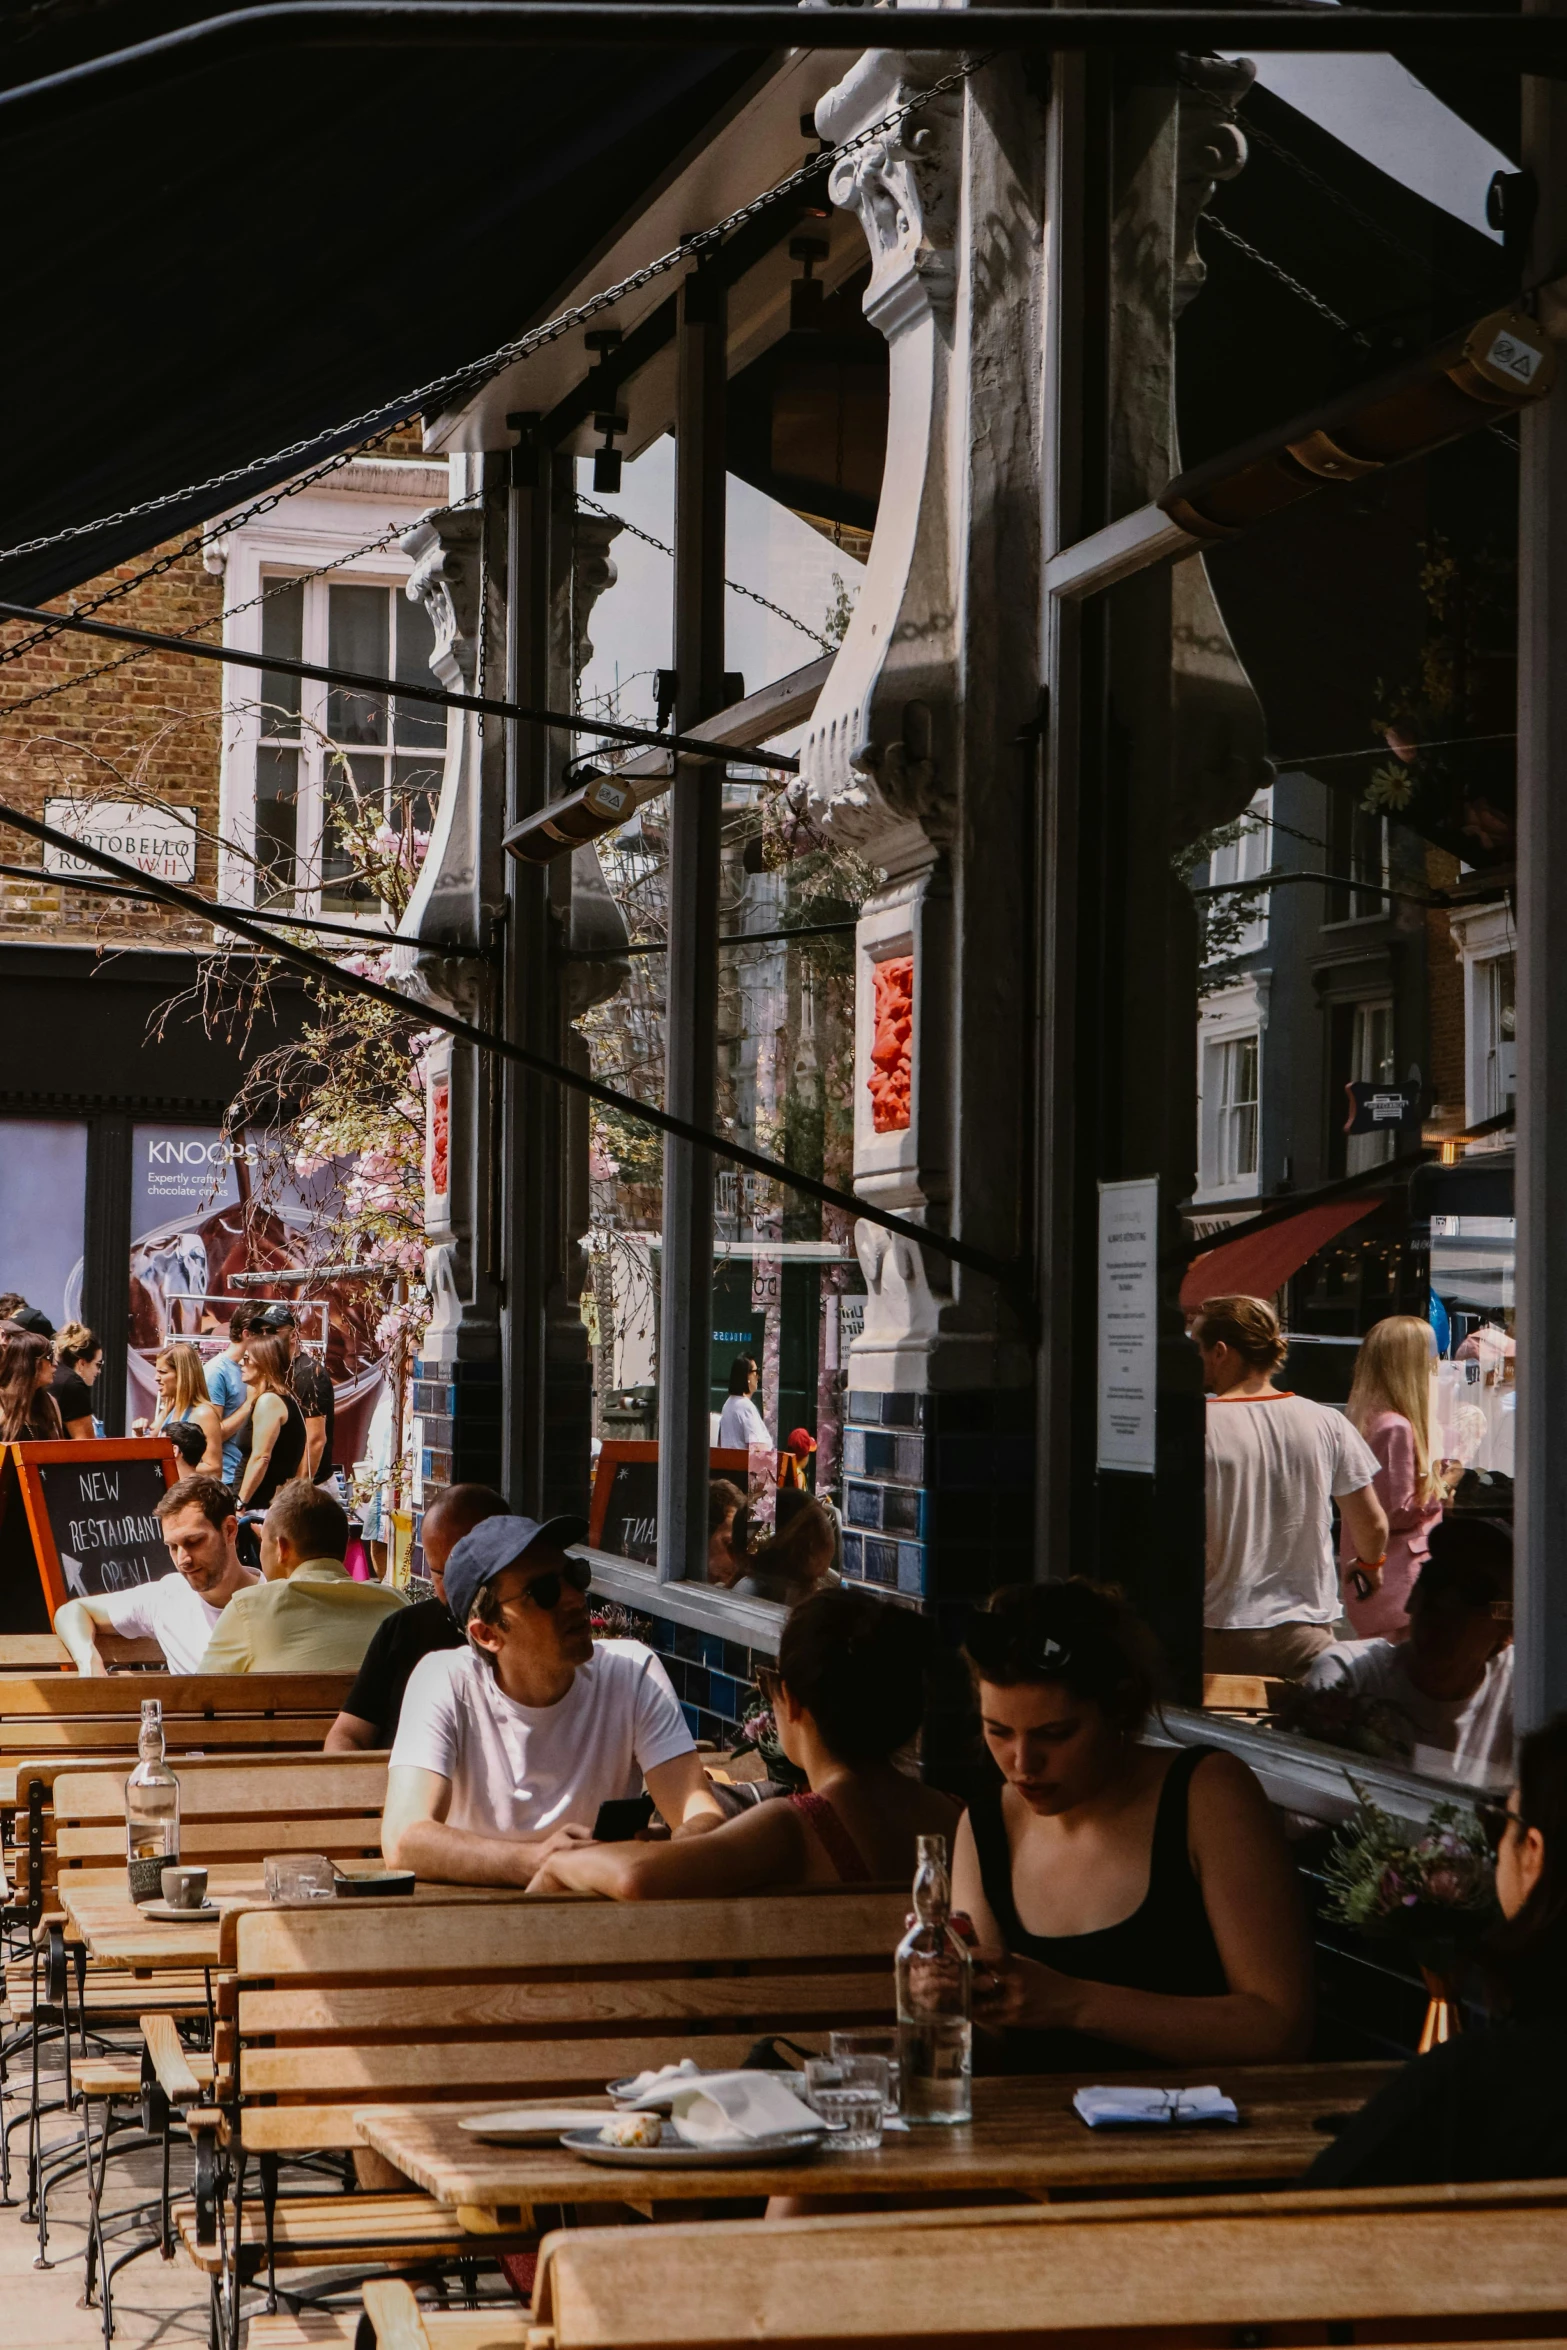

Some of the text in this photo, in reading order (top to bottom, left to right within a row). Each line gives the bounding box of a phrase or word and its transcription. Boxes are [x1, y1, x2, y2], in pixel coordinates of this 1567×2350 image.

[71, 834, 189, 857] RTOBELLO
[148, 1140, 259, 1167] KNOOPS
[147, 1172, 189, 1185] Expertly
[147, 1185, 196, 1196] chocolate
[79, 1471, 119, 1502] NEW
[68, 1515, 162, 1554] RESTAURANT
